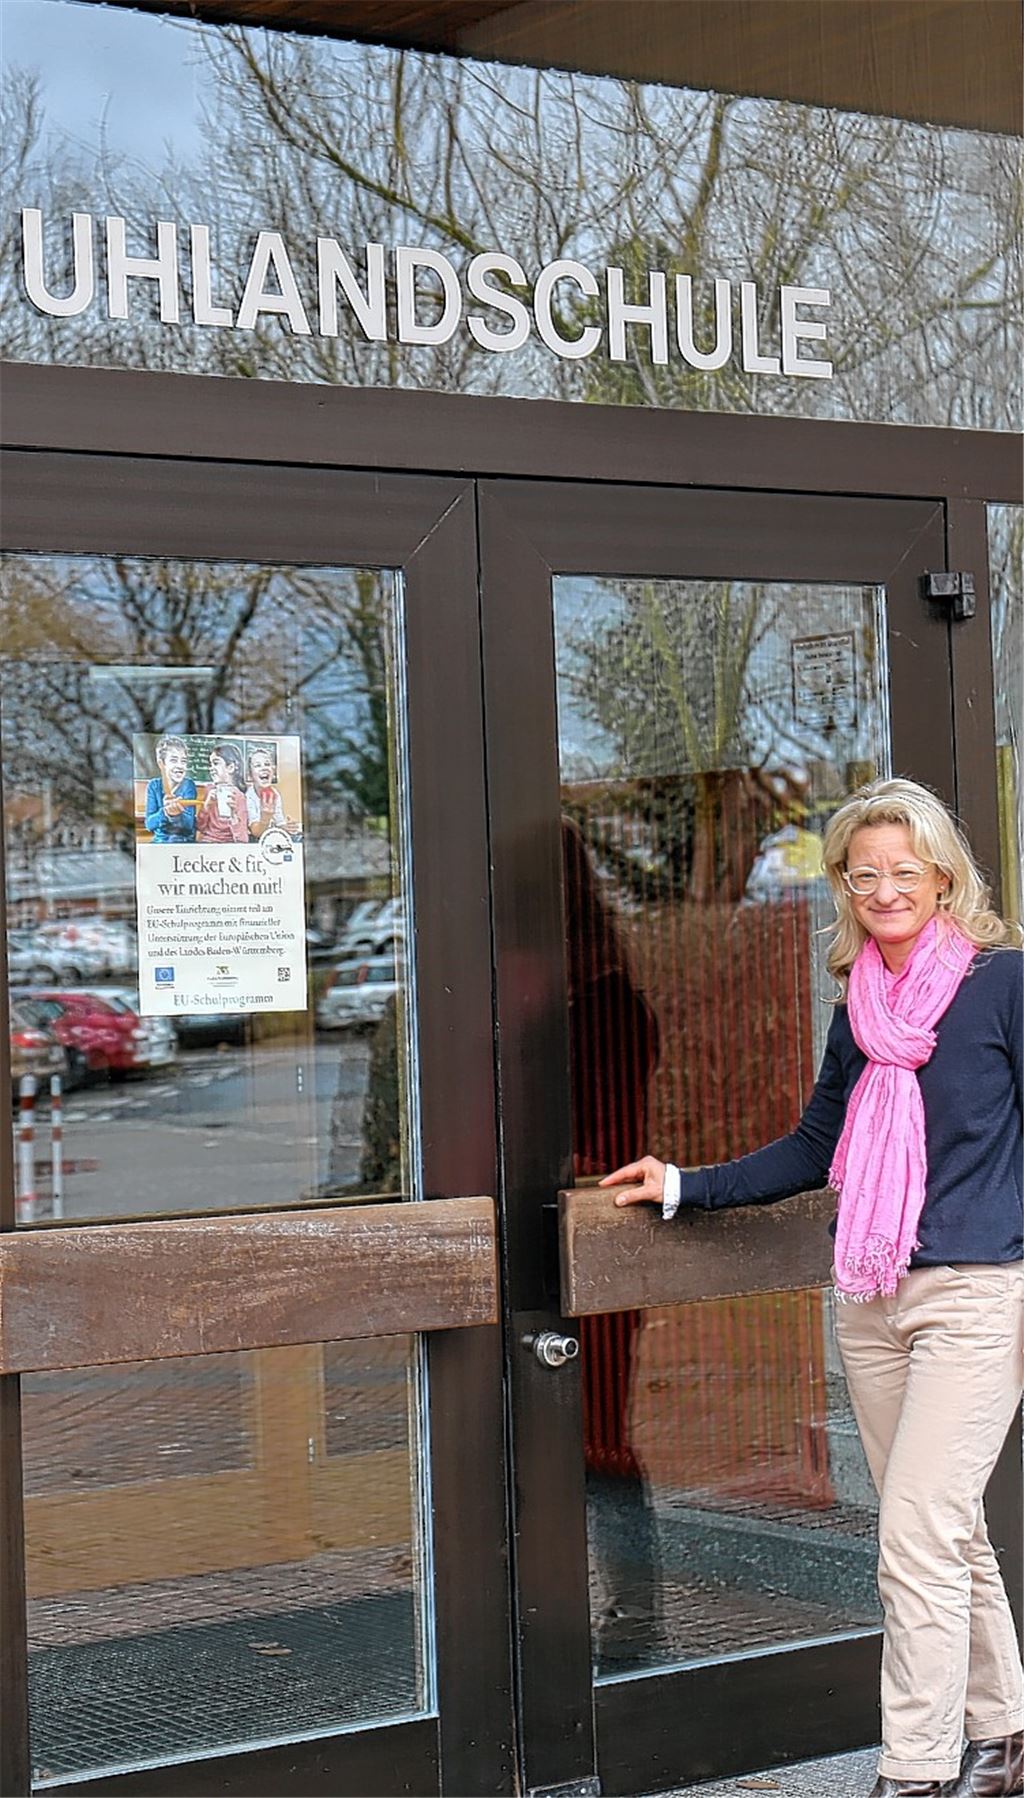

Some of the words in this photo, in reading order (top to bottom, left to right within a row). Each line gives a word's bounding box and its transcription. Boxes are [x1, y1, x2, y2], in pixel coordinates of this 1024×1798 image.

[22, 207, 833, 379] UHLANDSCHULE
[172, 855, 225, 873] Lecker
[228, 857, 243, 873] &
[246, 854, 267, 875] fit,
[158, 879, 185, 895] wir
[189, 877, 249, 895] machen
[253, 877, 283, 895] mit!
[173, 993, 274, 1008] EU-Schulprogramm
